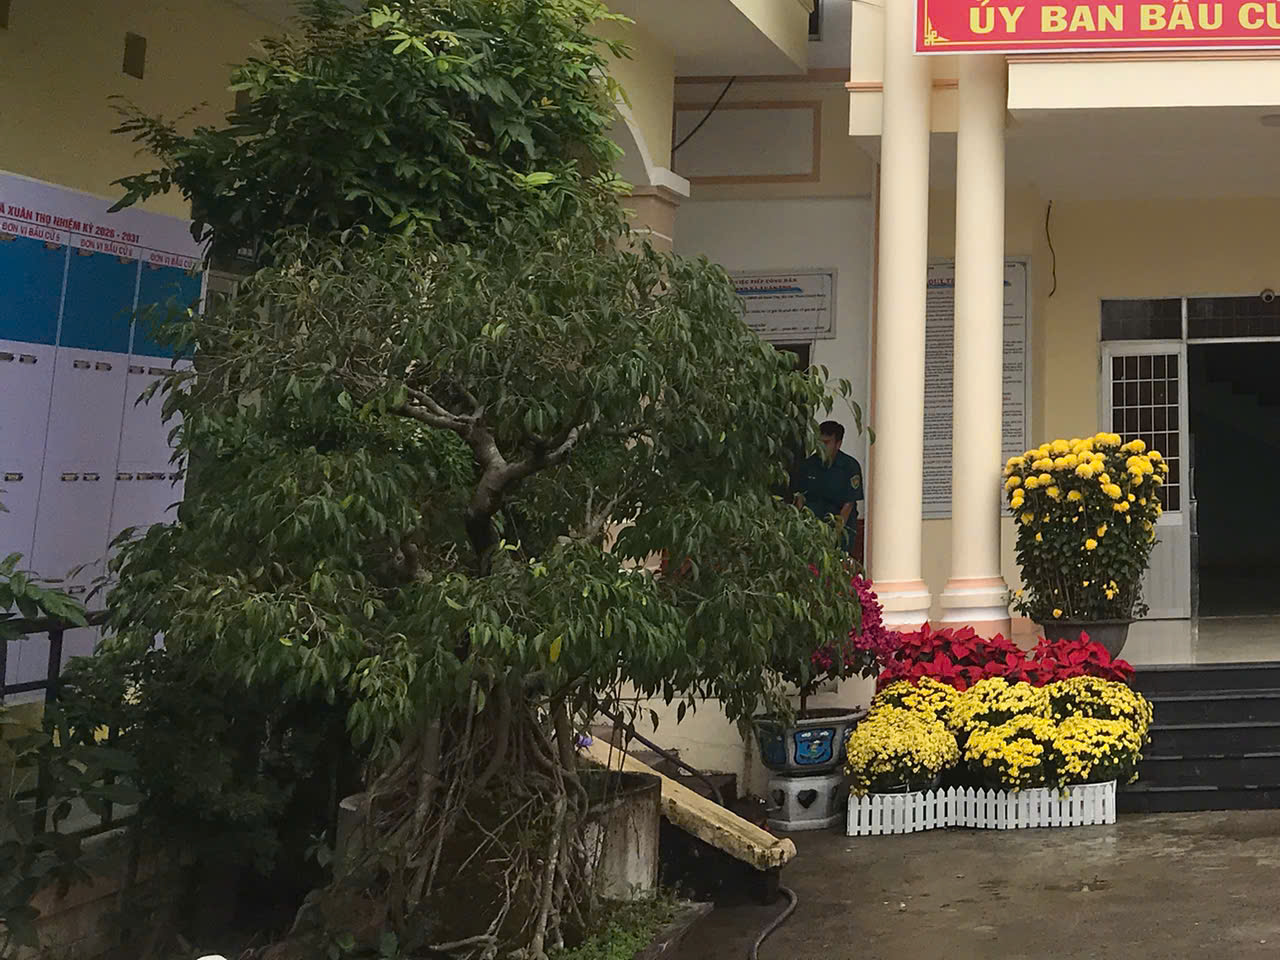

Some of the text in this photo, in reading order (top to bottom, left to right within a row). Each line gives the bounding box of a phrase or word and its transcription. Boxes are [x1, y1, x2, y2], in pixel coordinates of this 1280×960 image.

[1042, 4, 1125, 33] BAN
[7, 205, 33, 220] XUÂN
[35, 211, 52, 226] THỌ
[121, 231, 139, 243] 2031
